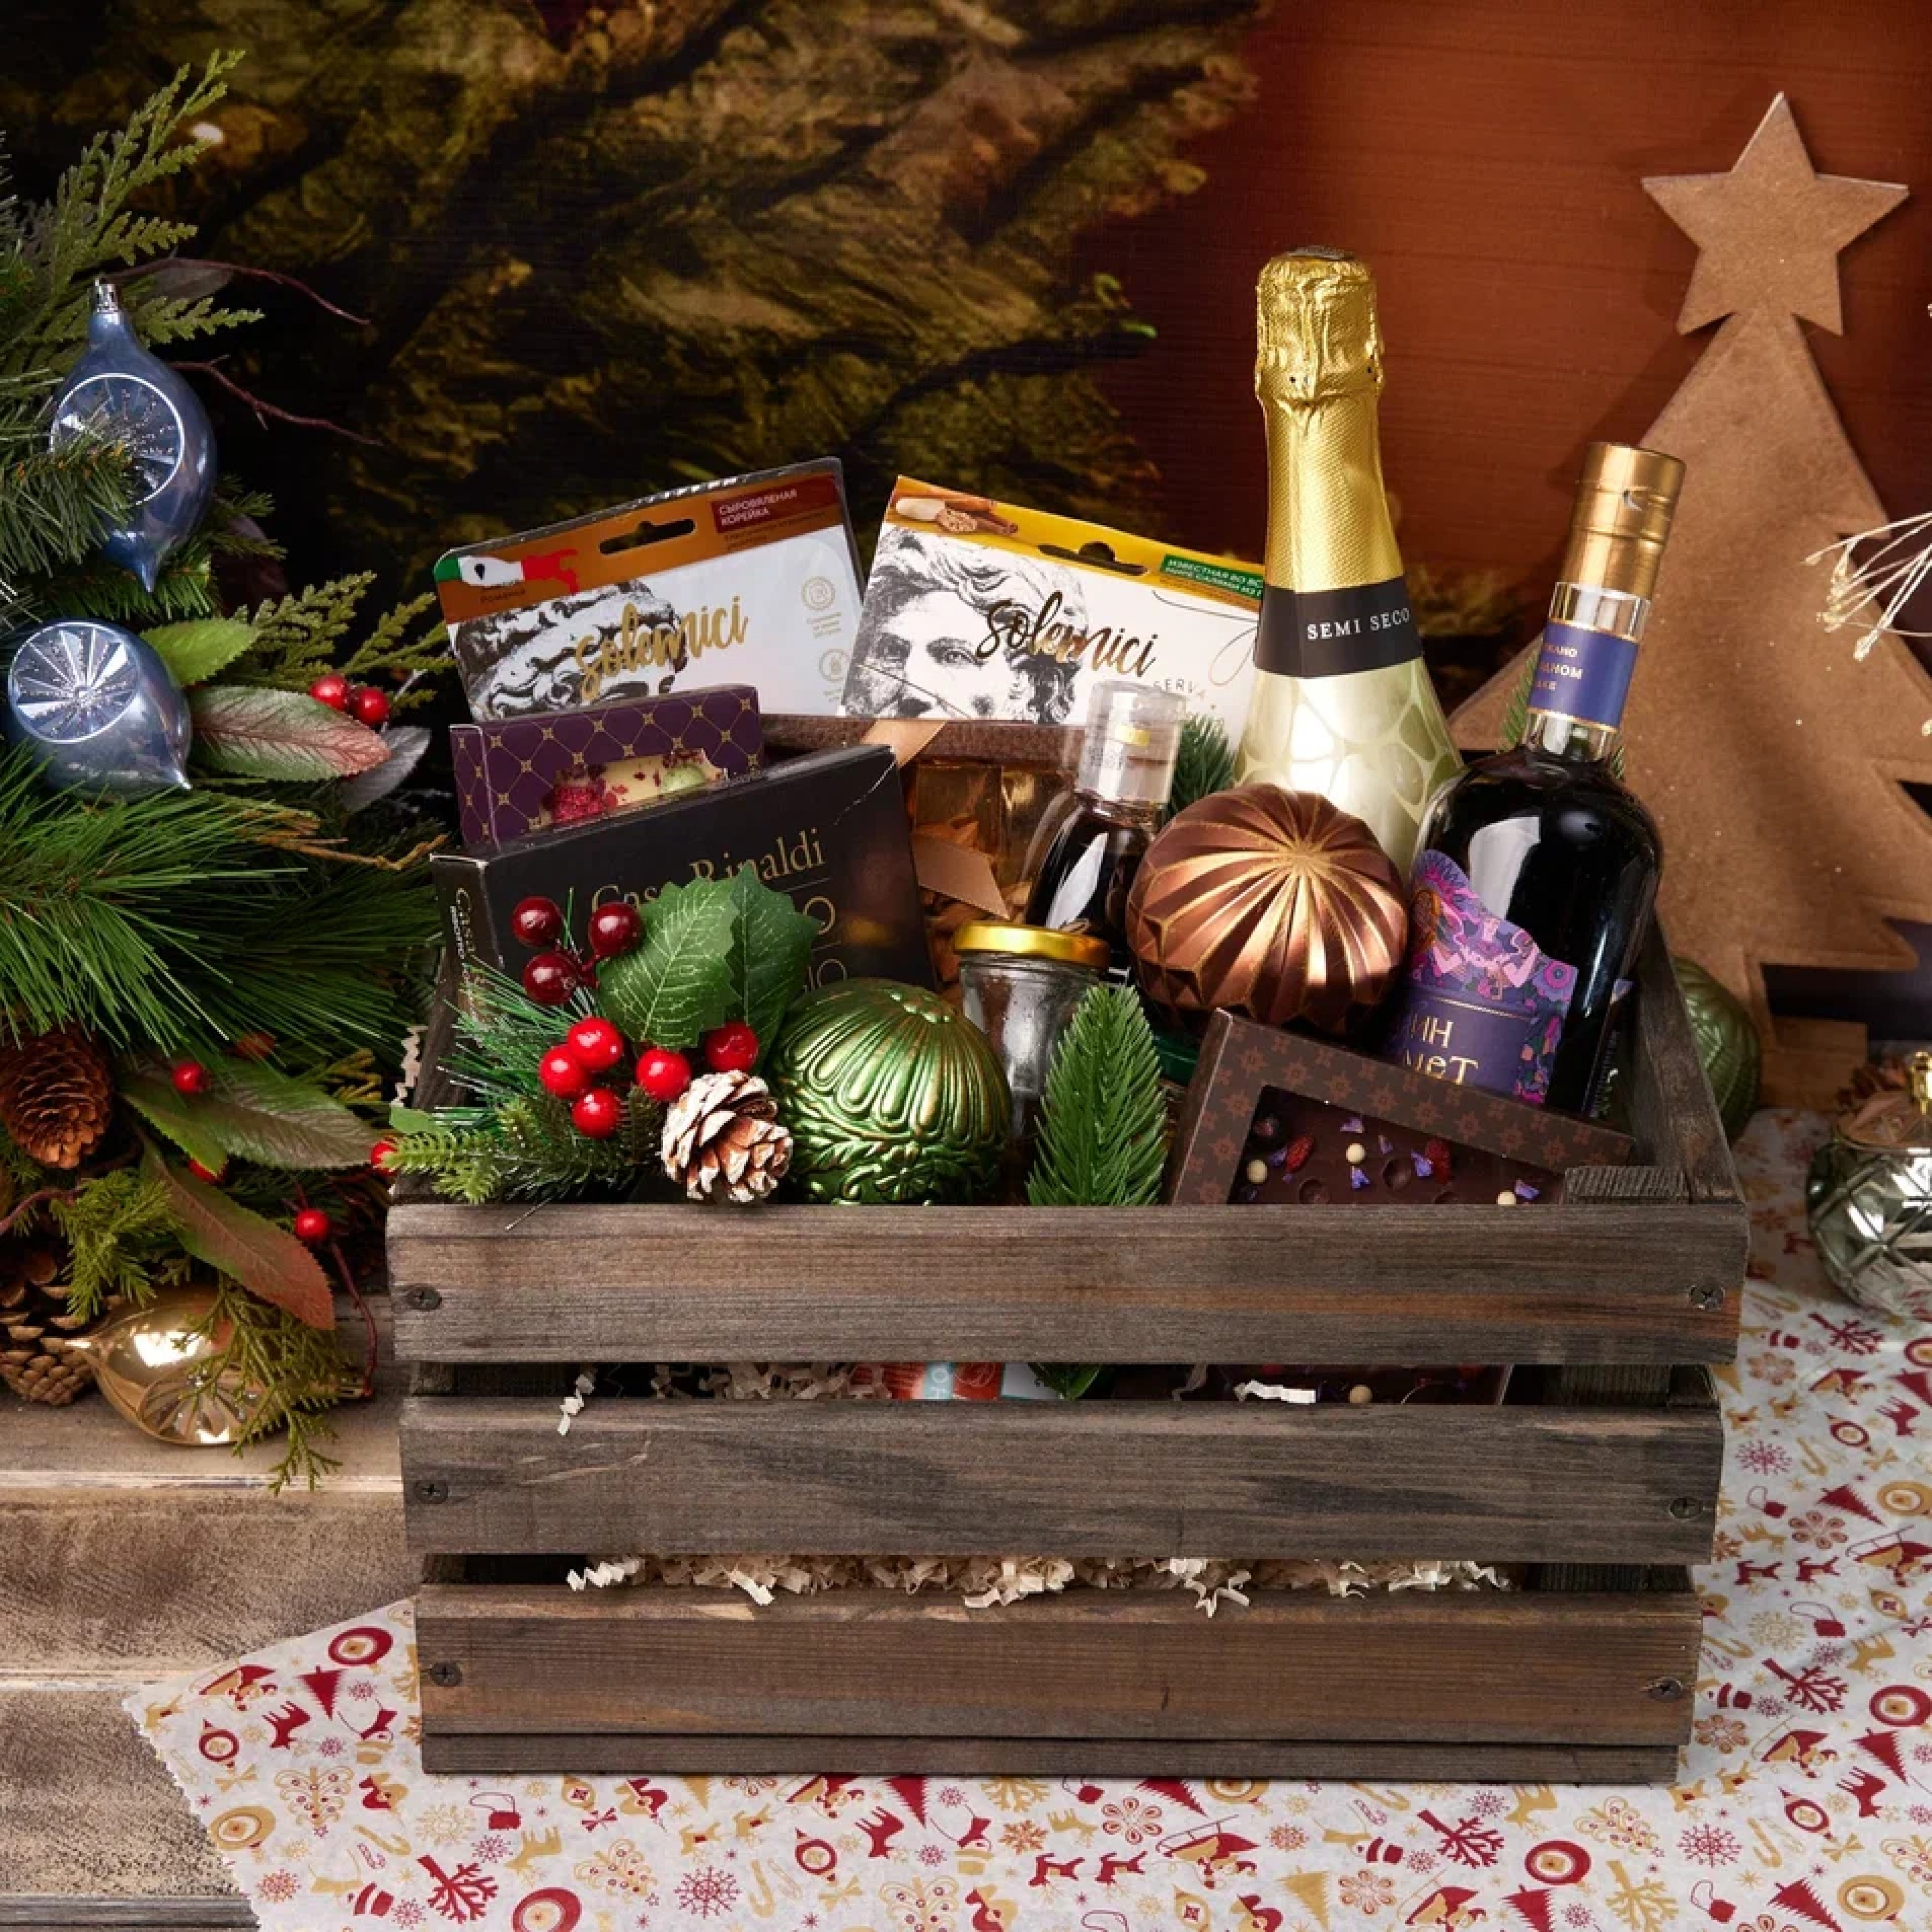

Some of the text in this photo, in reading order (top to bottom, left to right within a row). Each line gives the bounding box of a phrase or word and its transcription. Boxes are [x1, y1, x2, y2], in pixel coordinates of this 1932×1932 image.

[721, 506, 771, 526] КОРЕЙКА
[1167, 559, 1229, 578] ИЗВЕСТНАЯ
[1307, 607, 1410, 641] SEMI SECO
